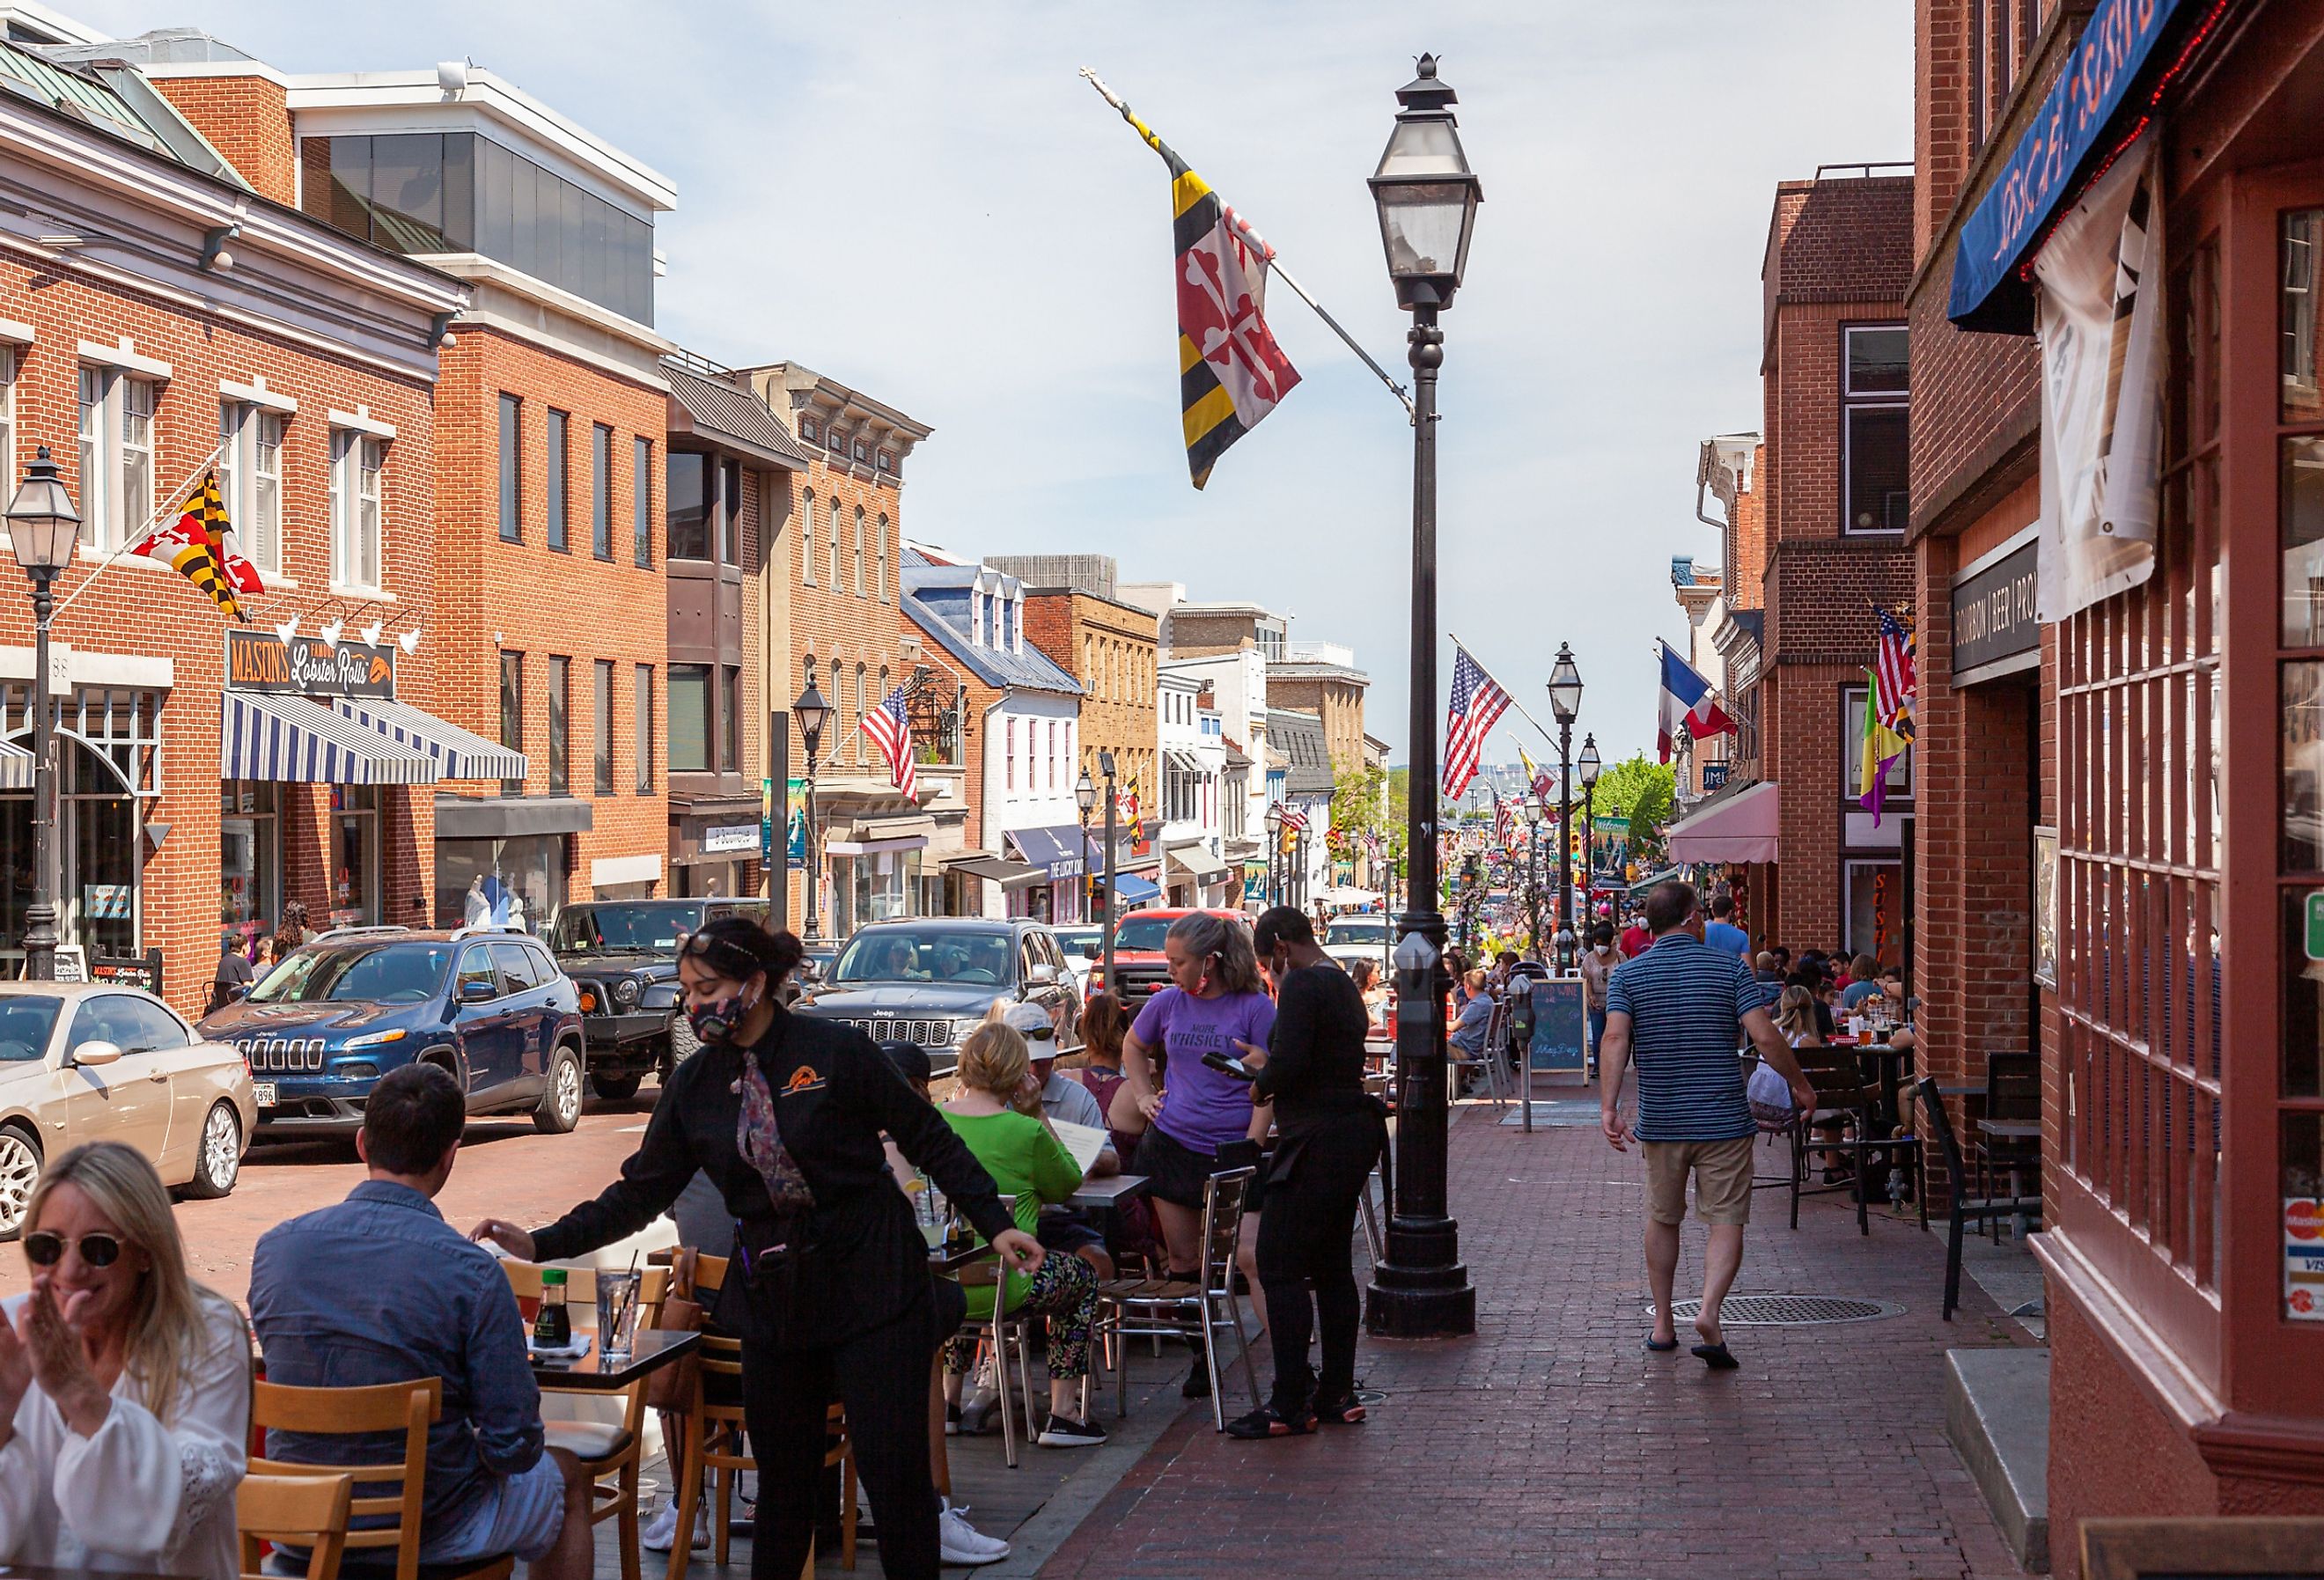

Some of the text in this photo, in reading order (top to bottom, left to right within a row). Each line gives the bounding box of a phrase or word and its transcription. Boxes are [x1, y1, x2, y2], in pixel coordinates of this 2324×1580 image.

[1956, 599, 1986, 647] BOURBON
[1992, 586, 2010, 633] BEER
[231, 639, 290, 683] MASON'S
[290, 643, 338, 688] Lobster
[1873, 873, 1886, 963] SUSHI
[873, 1009, 894, 1018] Jeep
[1190, 1024, 1218, 1033] MORE
[1170, 1033, 1233, 1048] WHISKEY
